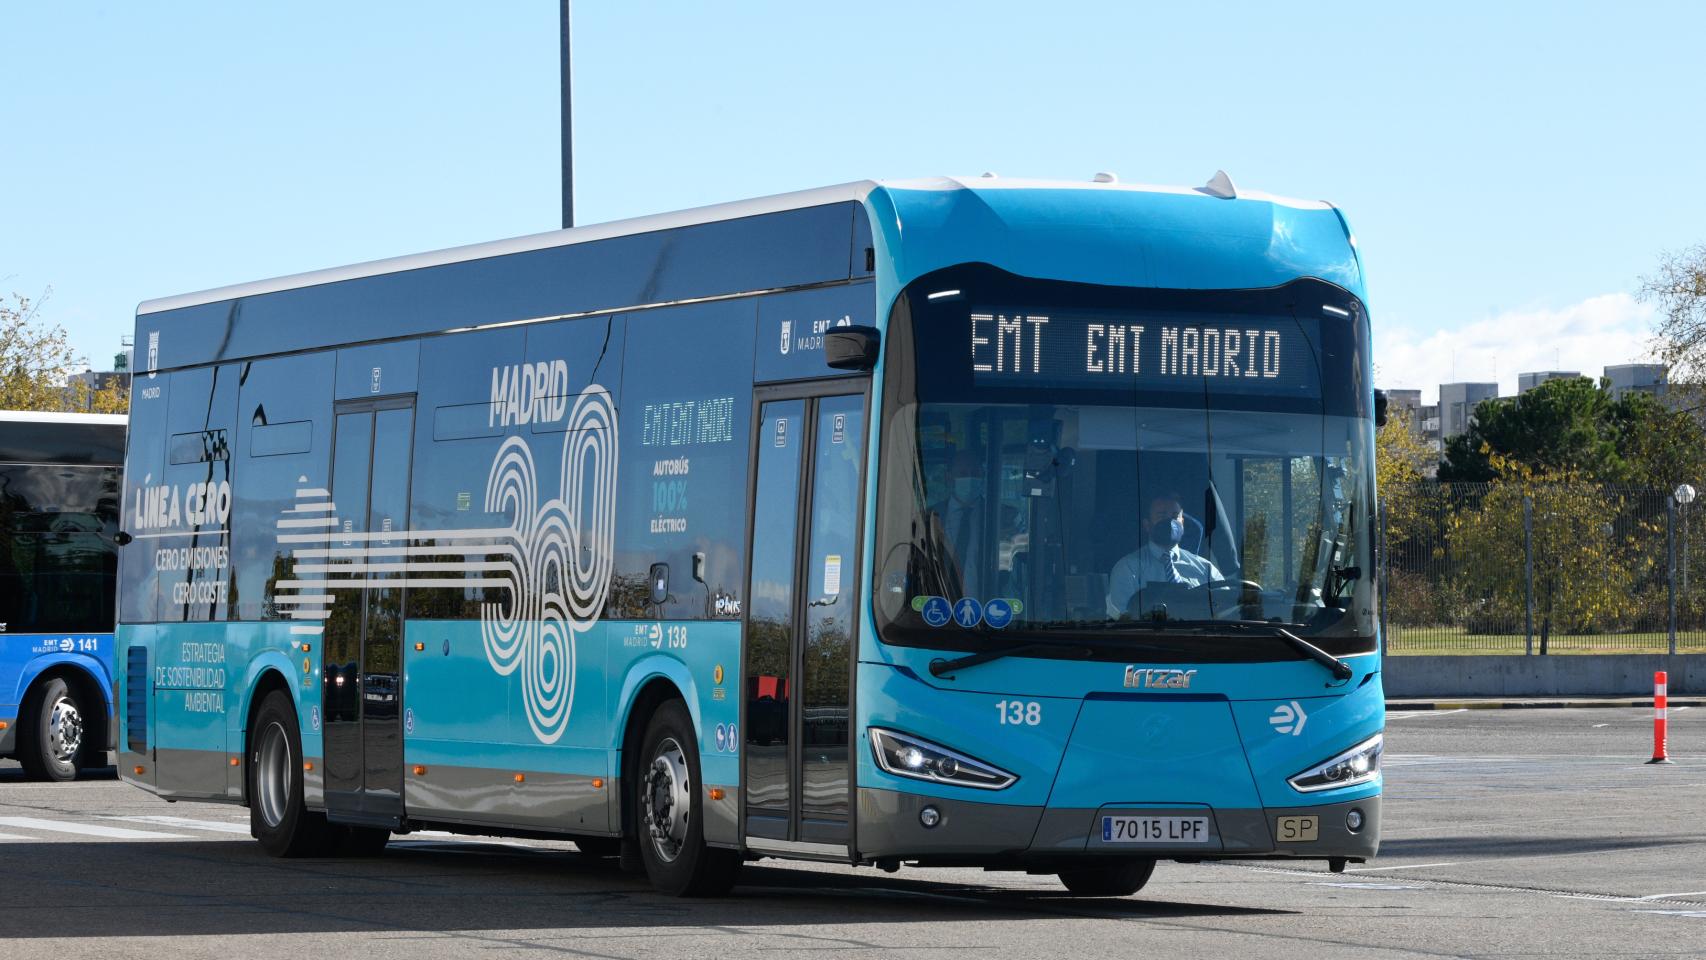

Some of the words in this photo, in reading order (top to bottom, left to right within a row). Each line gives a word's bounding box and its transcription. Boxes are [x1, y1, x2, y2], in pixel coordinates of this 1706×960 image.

[813, 320, 831, 334] EMT
[798, 336, 824, 351] MADRI
[971, 314, 1049, 373] EMT
[1086, 324, 1144, 374] EMT
[1160, 326, 1280, 378] MADRID
[141, 386, 161, 400] MADRID
[488, 359, 568, 428] MADRID
[653, 455, 689, 476] AUTOBÚS
[135, 472, 180, 530] LÍNEA
[185, 480, 231, 526] CERO
[652, 480, 688, 513] 100%
[650, 514, 687, 534] ELÉCTRICO
[155, 548, 179, 571] CERO
[180, 546, 229, 570] EMISIONES
[173, 581, 197, 605] CERO
[198, 580, 227, 604] COSTE
[78, 638, 98, 651] 141
[623, 636, 648, 647] MADRID
[635, 624, 649, 635] EMT
[667, 625, 687, 649] 138
[182, 642, 225, 663] ESTRATEGIA
[155, 666, 166, 687] DE
[167, 666, 226, 689] SOSTENIBILIDAD
[184, 692, 225, 714] AMBIENTAL
[995, 700, 1041, 726] 138
[1115, 820, 1163, 839] 7015
[1169, 820, 1204, 839] LPF
[1283, 819, 1313, 838] SP
